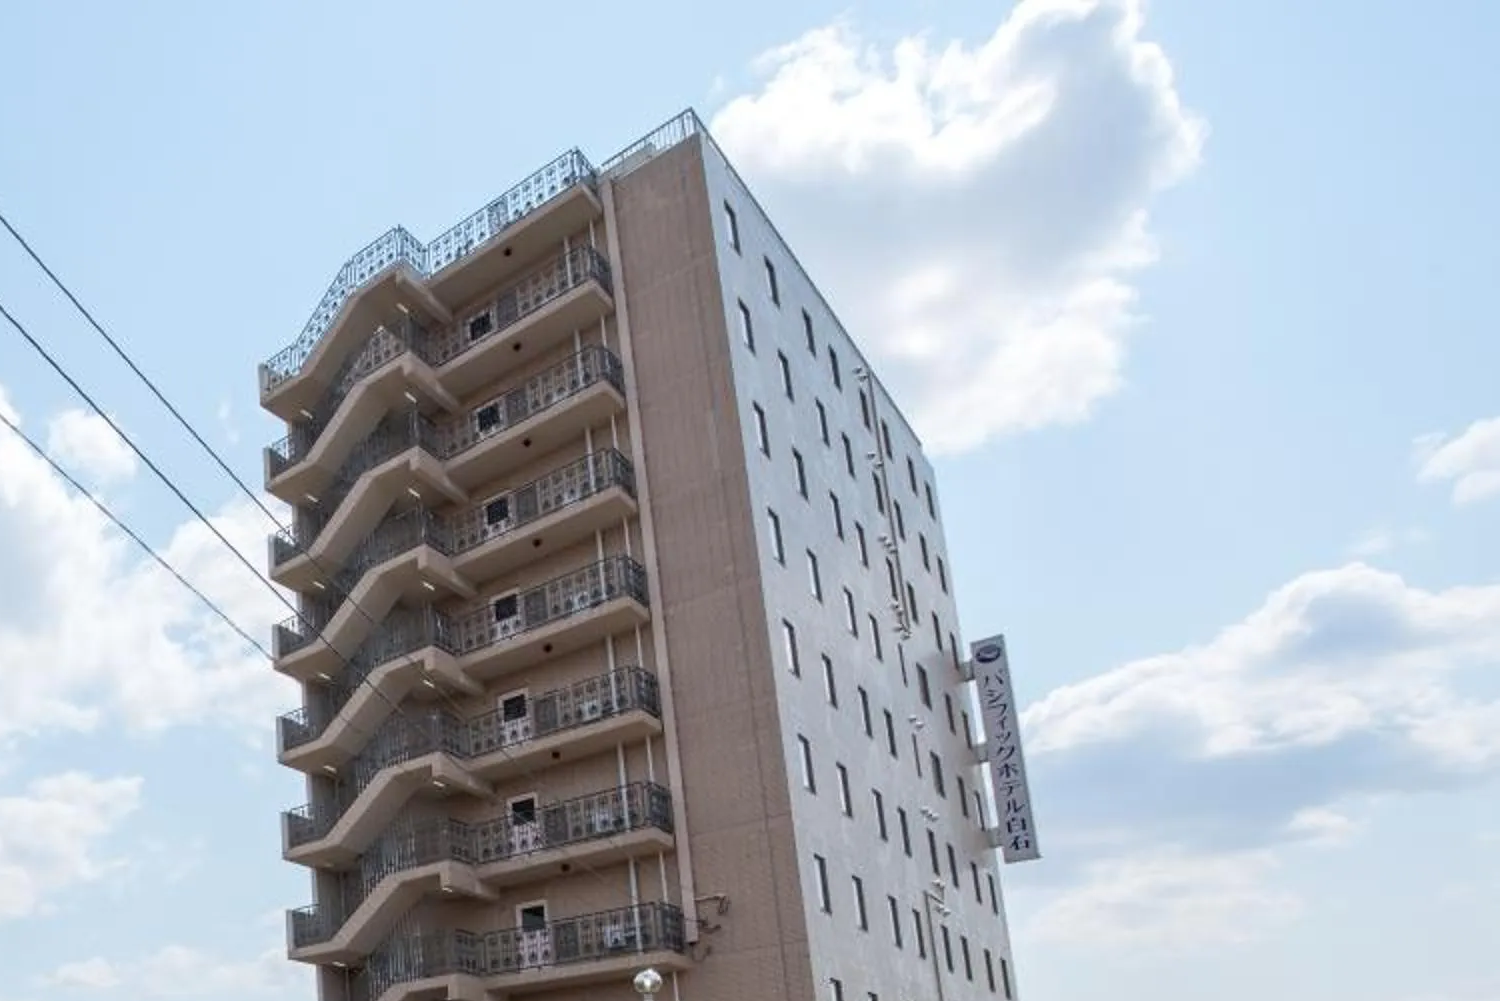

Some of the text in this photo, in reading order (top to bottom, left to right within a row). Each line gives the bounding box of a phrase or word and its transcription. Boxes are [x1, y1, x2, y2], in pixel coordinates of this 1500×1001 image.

[984, 669, 1030, 850] パシフィックホテル白石
